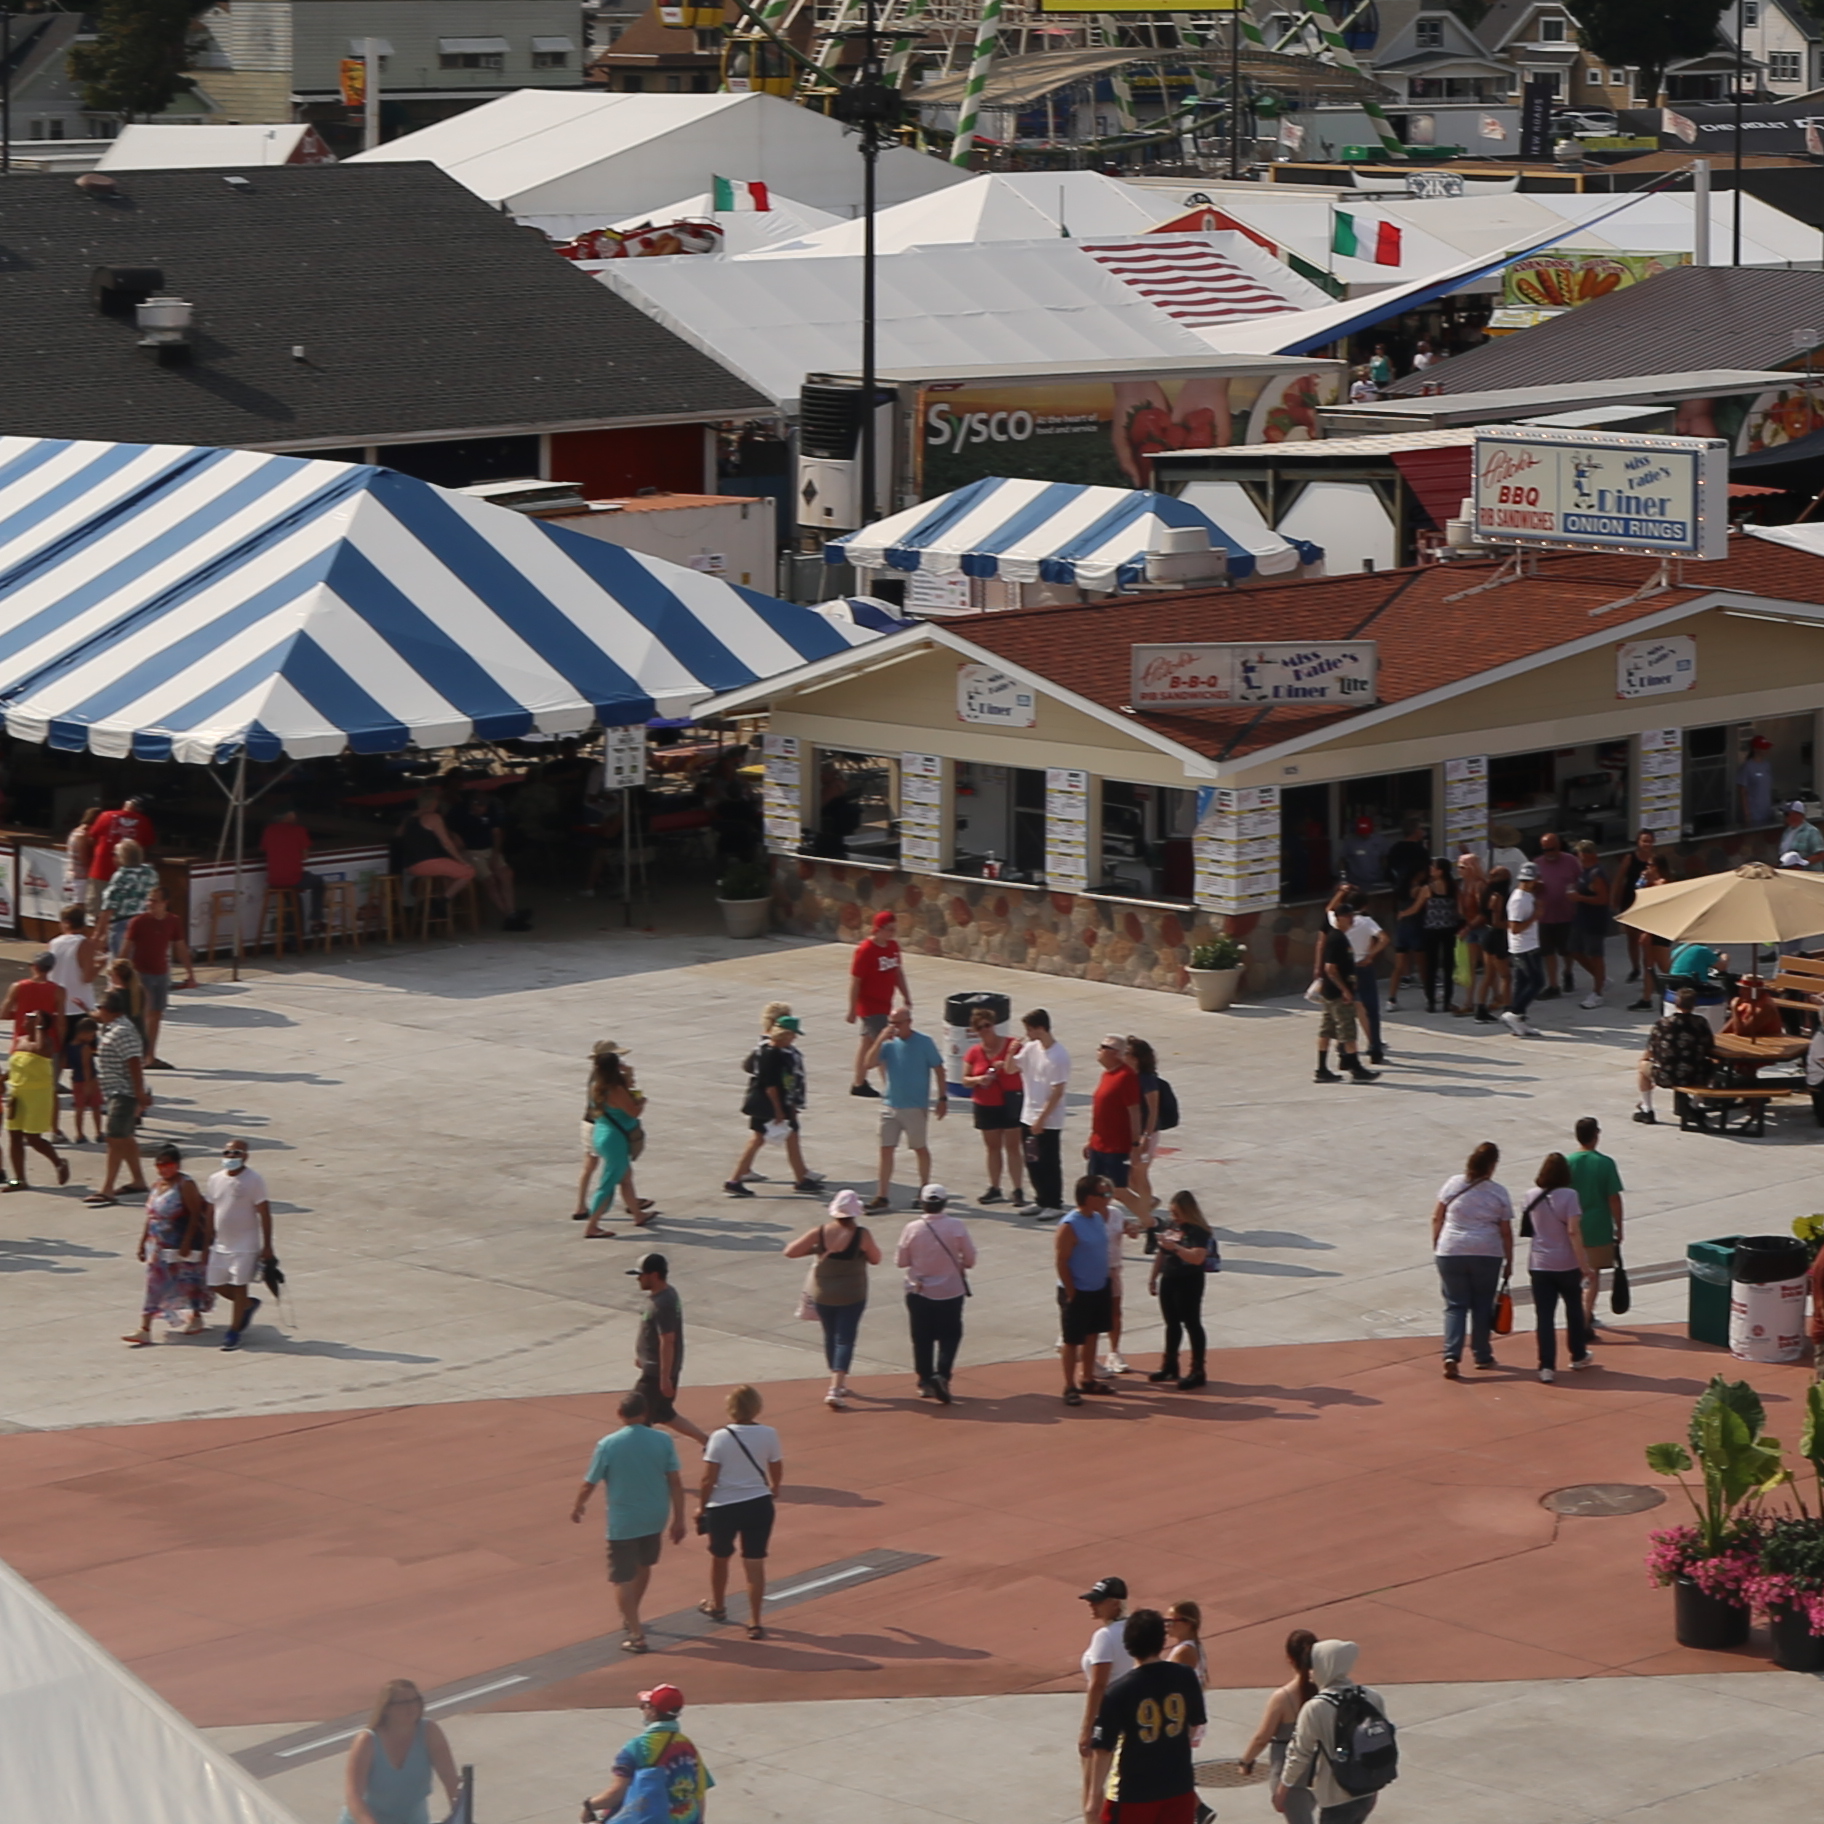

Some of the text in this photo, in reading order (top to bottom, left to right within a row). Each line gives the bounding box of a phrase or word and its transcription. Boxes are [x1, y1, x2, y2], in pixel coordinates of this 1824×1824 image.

[1498, 485, 1540, 507] BBQ
[1598, 488, 1673, 517] Diner
[1496, 508, 1555, 531] SANDWICHES
[1566, 516, 1685, 540] ONION RINGS
[1169, 675, 1219, 689] B-B-Q
[1273, 684, 1330, 699] Diner
[1339, 676, 1369, 695] Lite
[1160, 690, 1230, 701] SANDWICHES
[1136, 1692, 1187, 1745] 99
